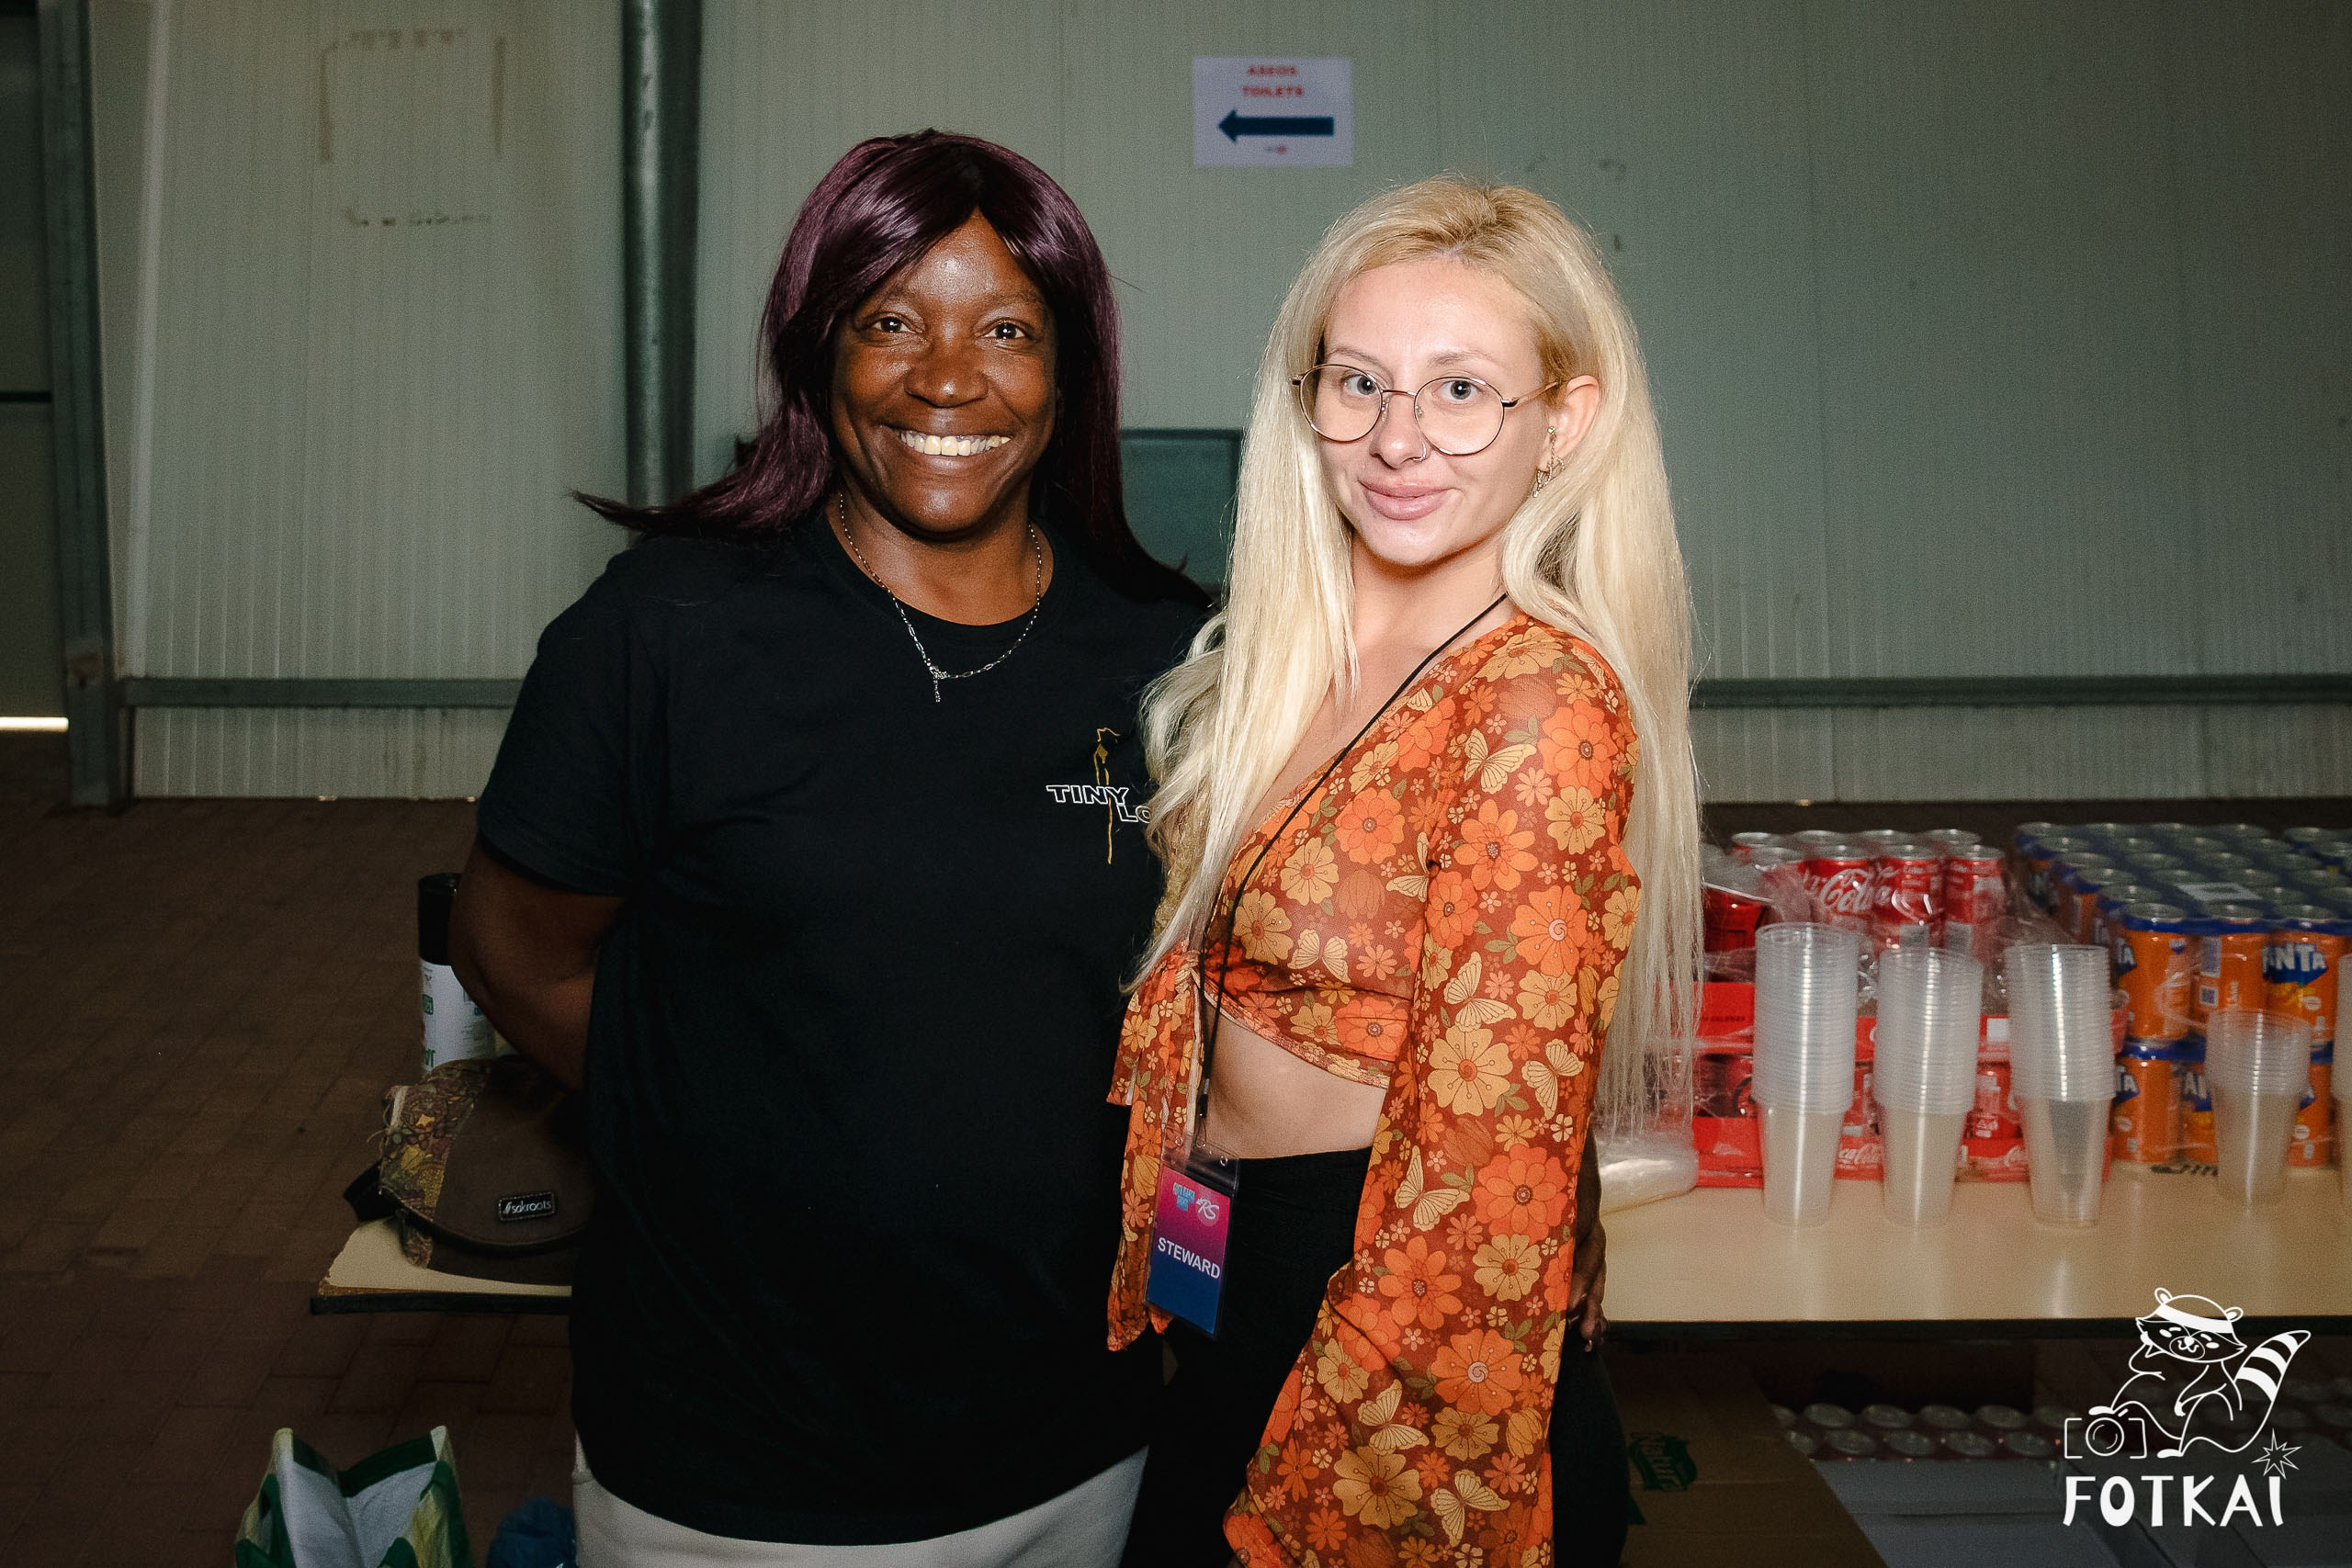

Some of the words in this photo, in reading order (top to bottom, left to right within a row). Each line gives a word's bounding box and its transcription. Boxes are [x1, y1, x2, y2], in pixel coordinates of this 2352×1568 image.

[1242, 85, 1304, 97] TOILETS
[1046, 784, 1129, 805] TINY
[2261, 943, 2326, 975] ANTA
[1158, 1236, 1221, 1280] STEWARD
